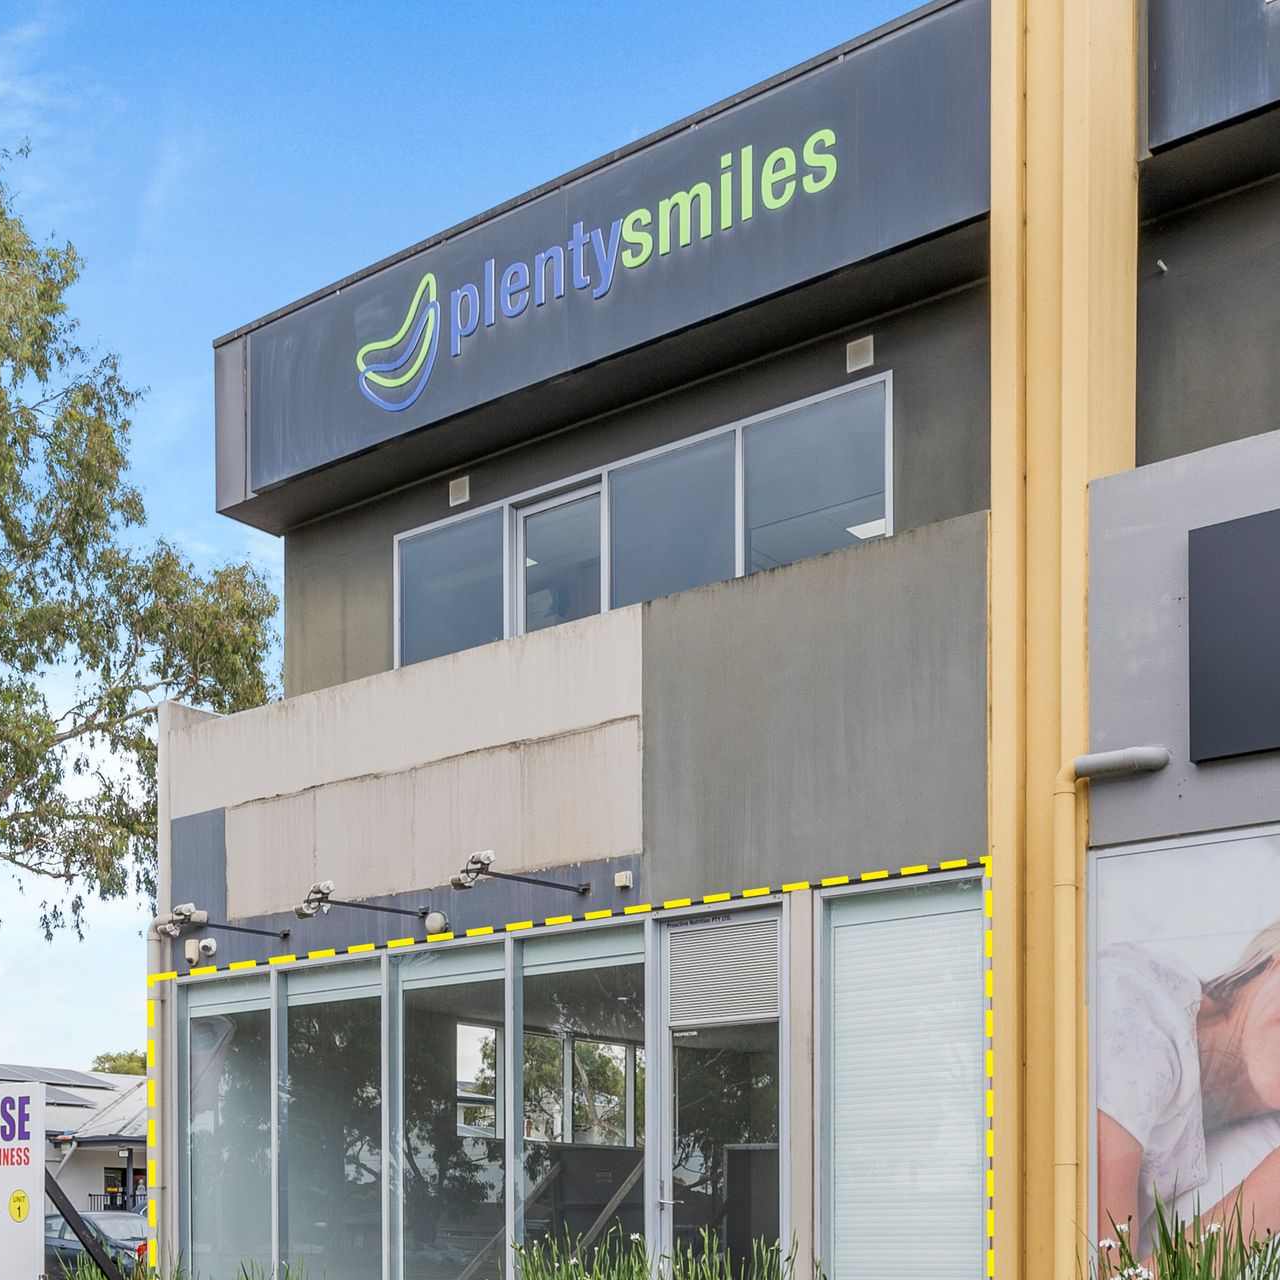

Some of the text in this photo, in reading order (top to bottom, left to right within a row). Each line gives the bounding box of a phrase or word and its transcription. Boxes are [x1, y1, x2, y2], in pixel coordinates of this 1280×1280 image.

[450, 128, 838, 358] plentysmiles
[12, 1195, 26, 1203] UNIT
[16, 1206, 21, 1218] 1
